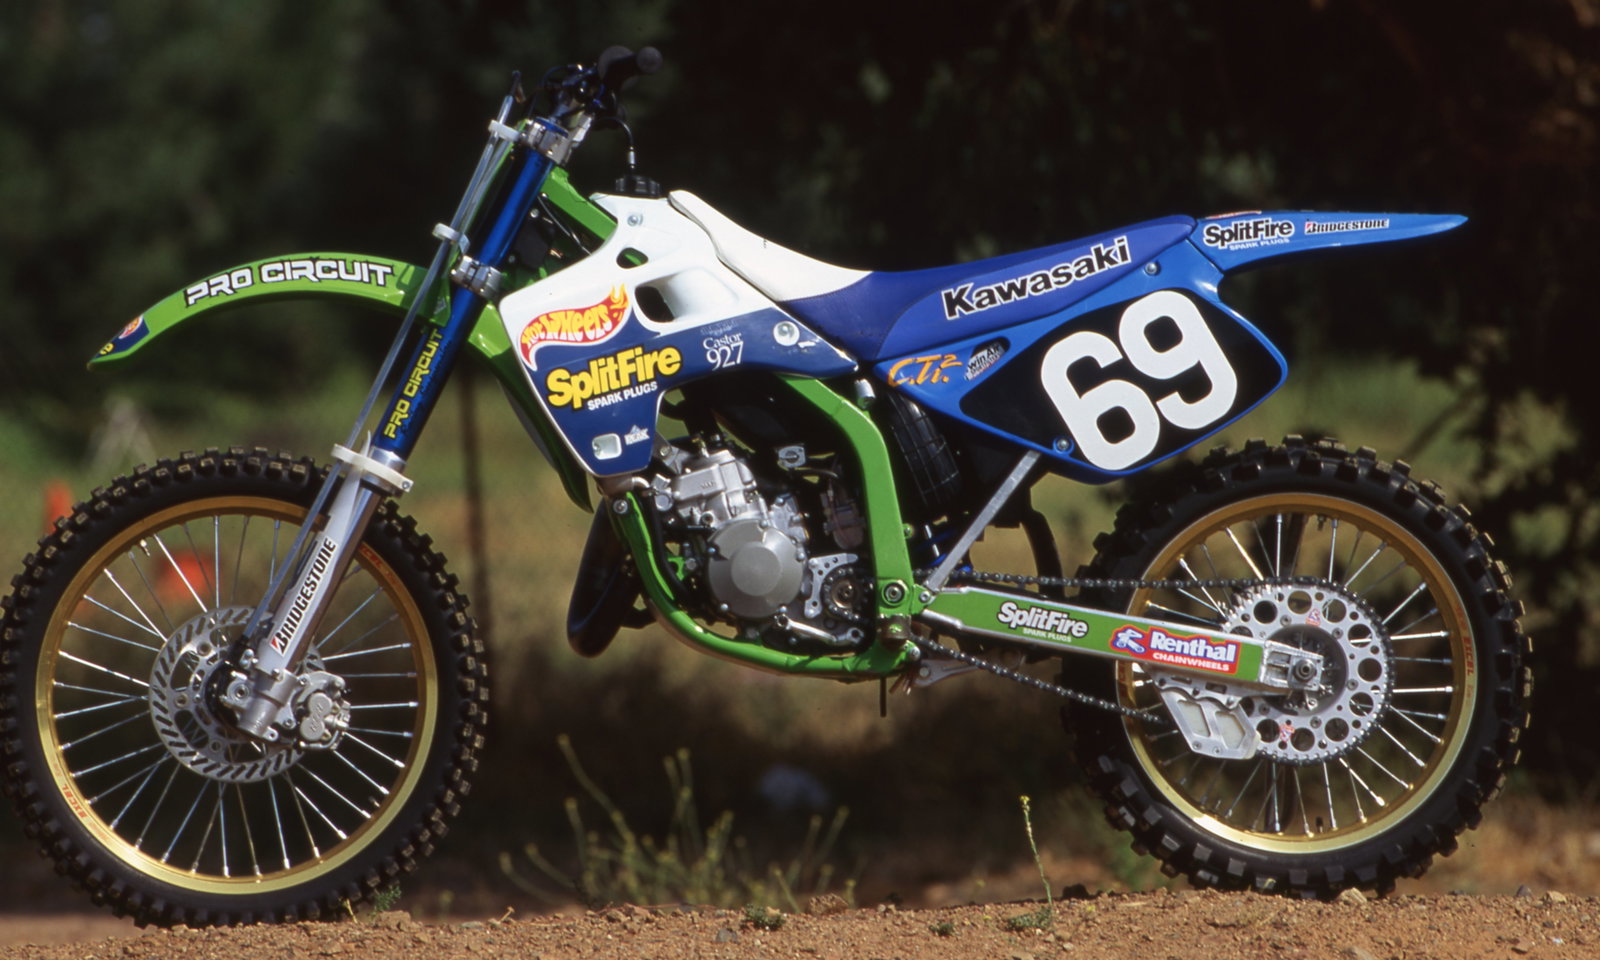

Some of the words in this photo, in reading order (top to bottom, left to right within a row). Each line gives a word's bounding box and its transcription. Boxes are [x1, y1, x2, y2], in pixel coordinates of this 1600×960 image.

[1204, 217, 1294, 248] SplitFire
[1305, 218, 1389, 234] BRIDGESTONE
[1229, 241, 1259, 251] SPARK
[1260, 238, 1290, 247] PLUGS
[185, 266, 253, 307] PRO
[260, 258, 393, 287] CIRCUIT
[941, 235, 1131, 320] Kawasaki
[703, 332, 742, 350] Castor
[706, 341, 744, 371] 927
[383, 398, 411, 439] PRO
[403, 328, 443, 398] CIRCUIT
[546, 346, 683, 411] SplitFire
[1040, 289, 1238, 471] 69
[587, 393, 624, 411] SPARK
[624, 381, 658, 399] PLUGS
[271, 537, 336, 654] BRIDGESTONE
[997, 601, 1089, 639] SplitFire
[1022, 627, 1047, 638] SPARK
[1047, 631, 1072, 643] PLUGS
[1149, 630, 1237, 663] Renthal
[1152, 652, 1230, 672] CHAINWHEELS
